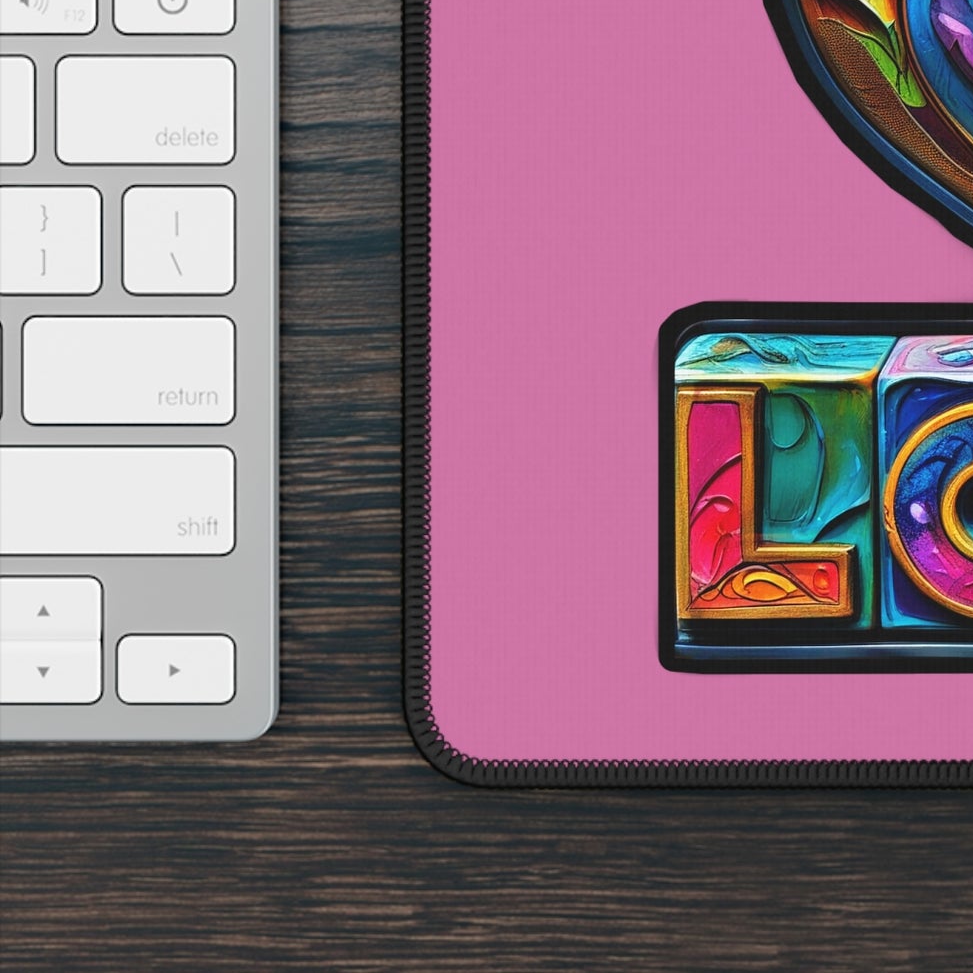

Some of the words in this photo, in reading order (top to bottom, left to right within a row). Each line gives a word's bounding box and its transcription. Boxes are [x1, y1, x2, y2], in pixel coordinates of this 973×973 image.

[155, 126, 219, 147] delete
[157, 388, 219, 406] return
[176, 516, 219, 536] shift
